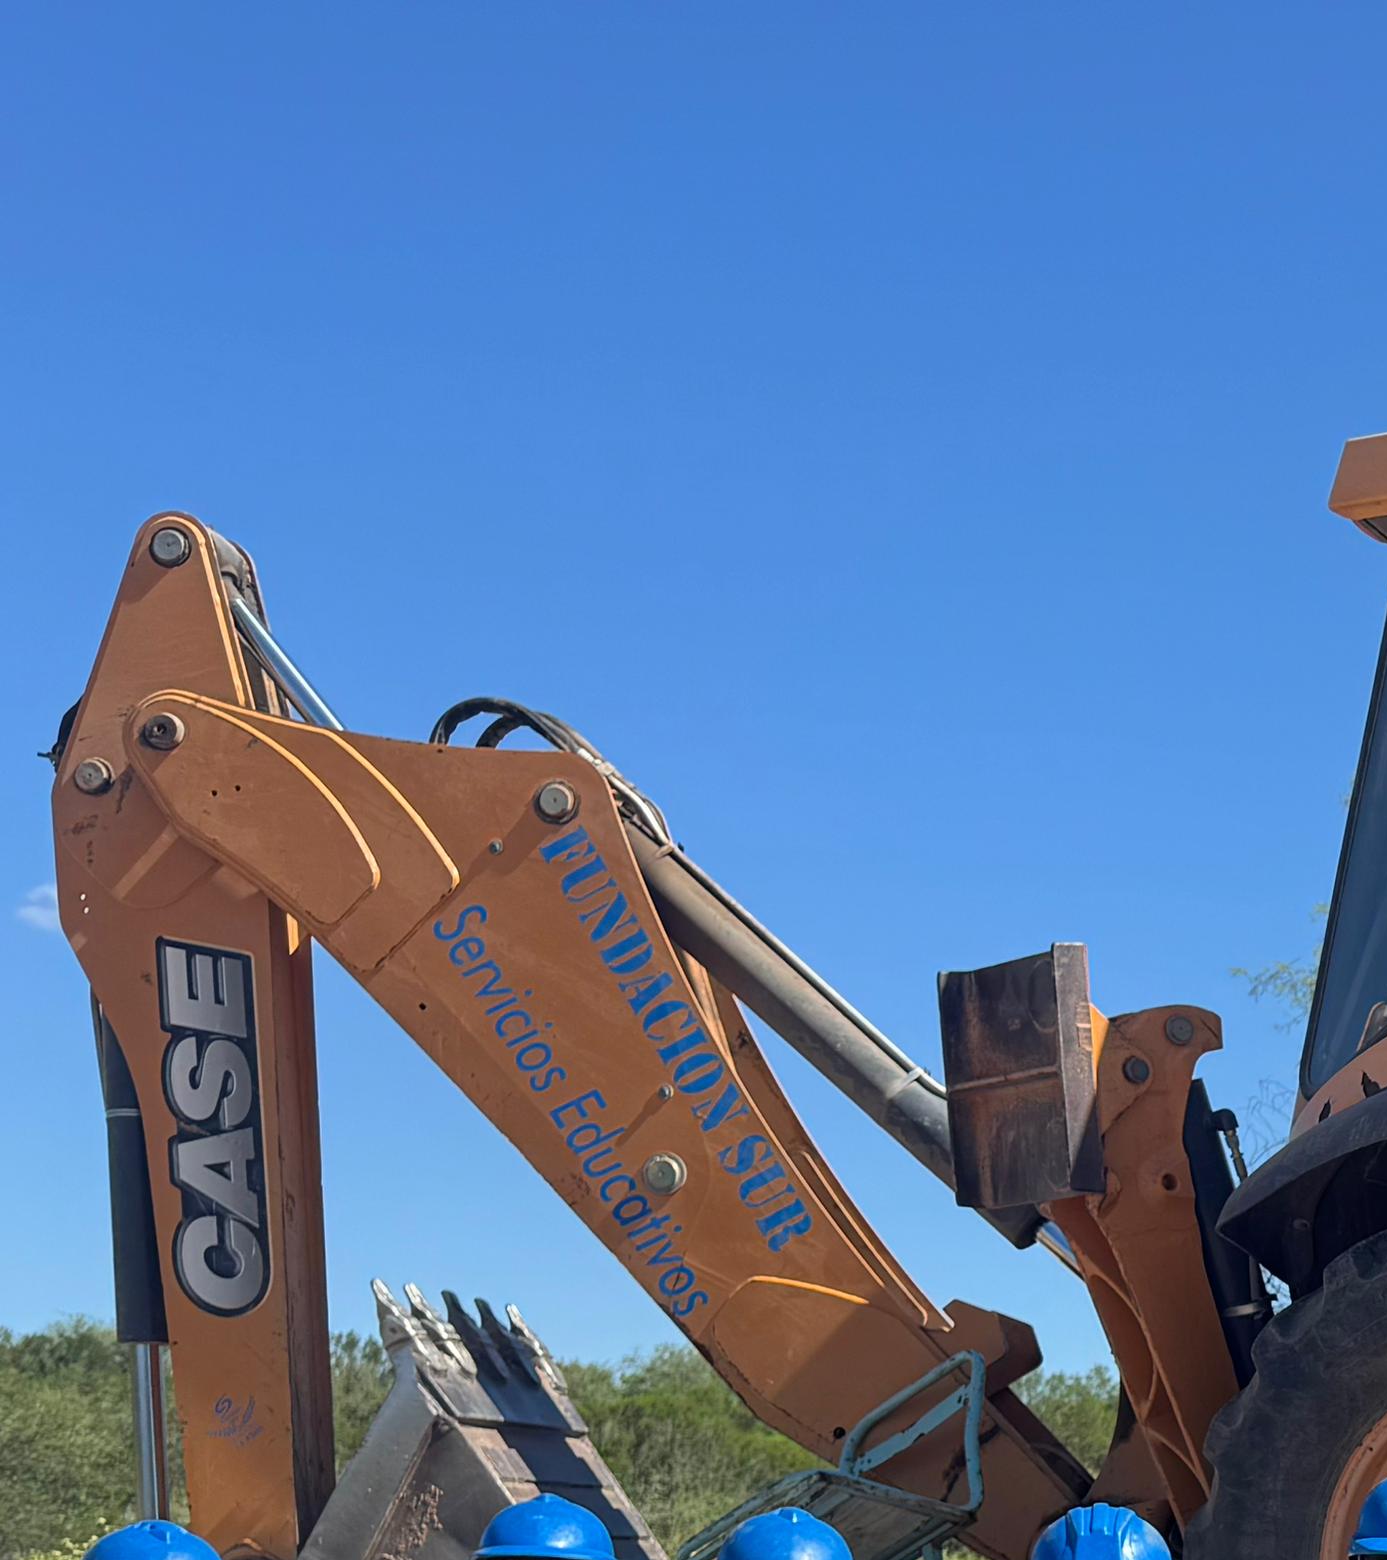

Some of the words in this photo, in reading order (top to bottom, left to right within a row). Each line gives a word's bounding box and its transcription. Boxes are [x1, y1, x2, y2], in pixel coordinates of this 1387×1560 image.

[160, 938, 271, 1314] CASE
[432, 903, 567, 1093] Servicios
[550, 1088, 710, 1319] Educativos
[540, 826, 747, 1131] FUNDACION
[718, 1133, 814, 1252] SUR
